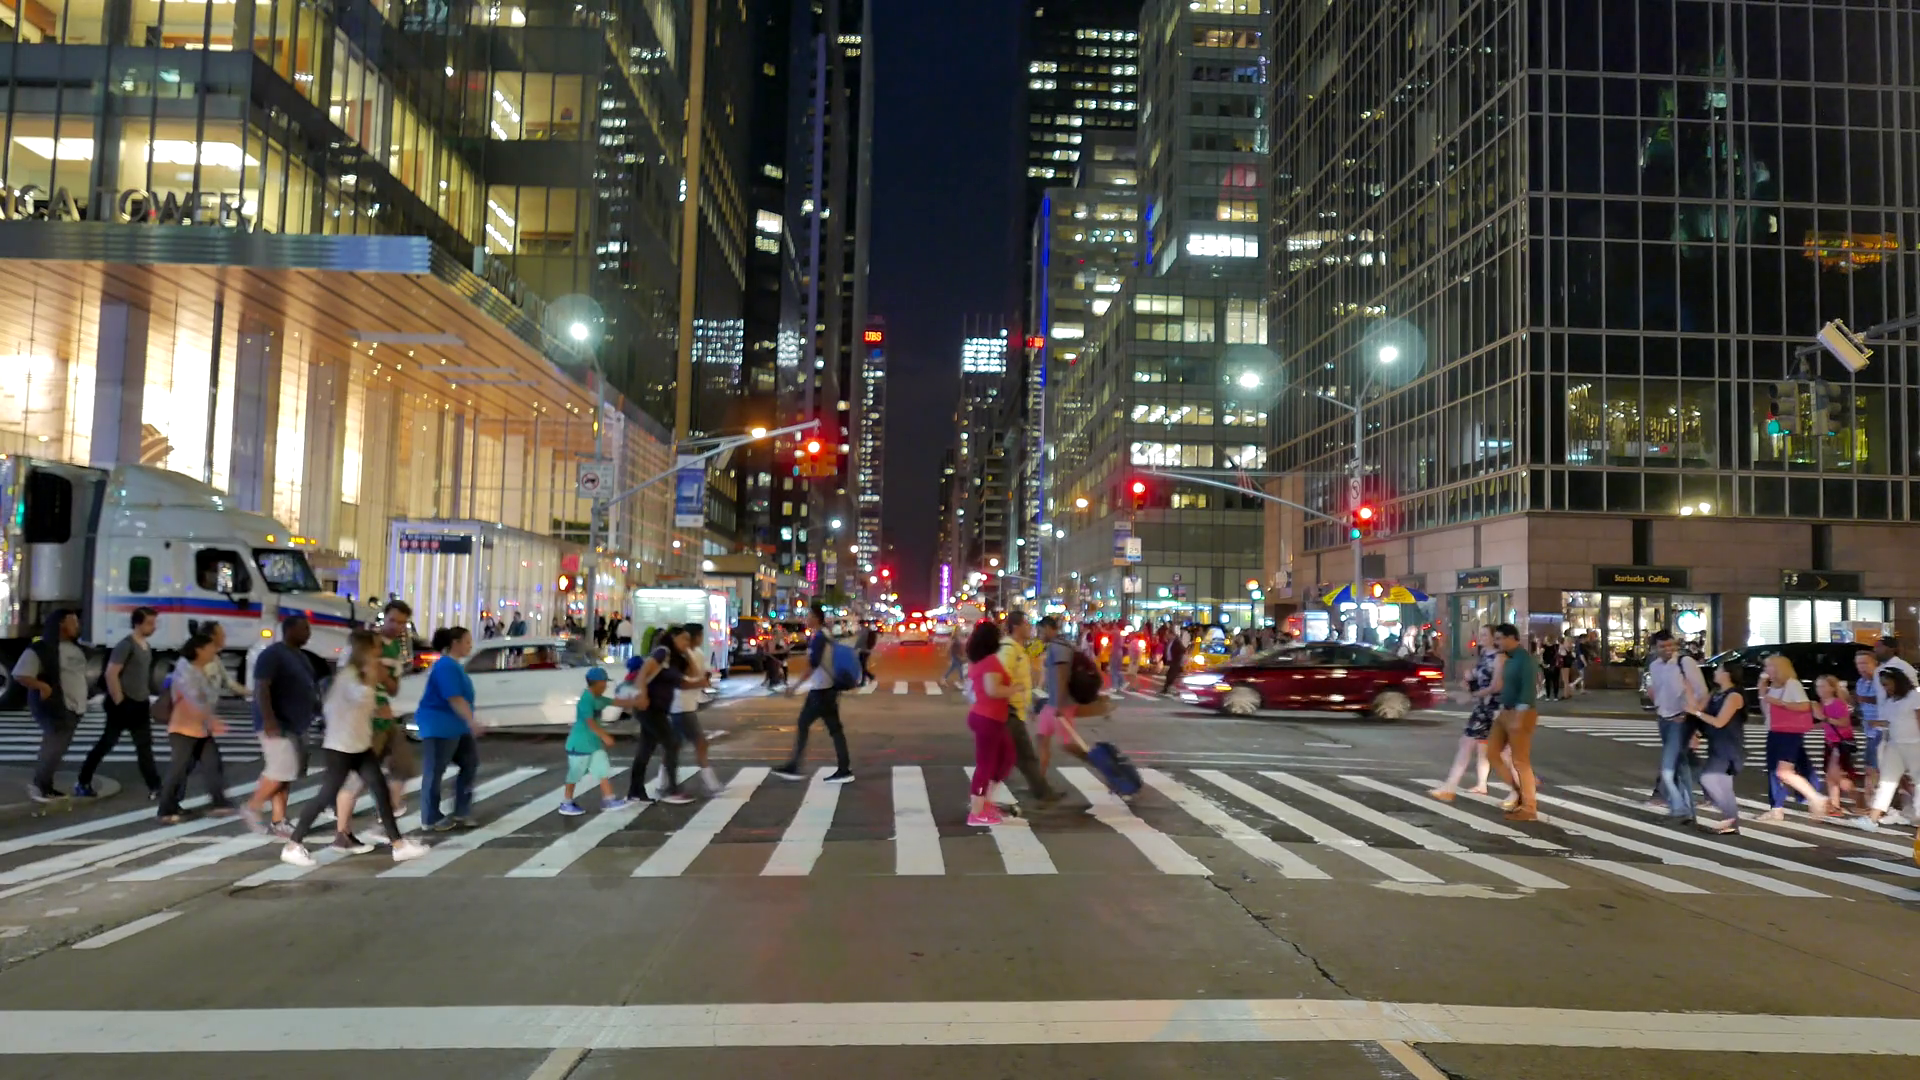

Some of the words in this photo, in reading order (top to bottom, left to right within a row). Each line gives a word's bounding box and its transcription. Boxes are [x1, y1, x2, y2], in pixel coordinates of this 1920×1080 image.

[96, 186, 257, 234] TOWER
[865, 331, 882, 342] UBS
[1614, 574, 1645, 582] Starbucks
[1648, 575, 1670, 583] Coffee
